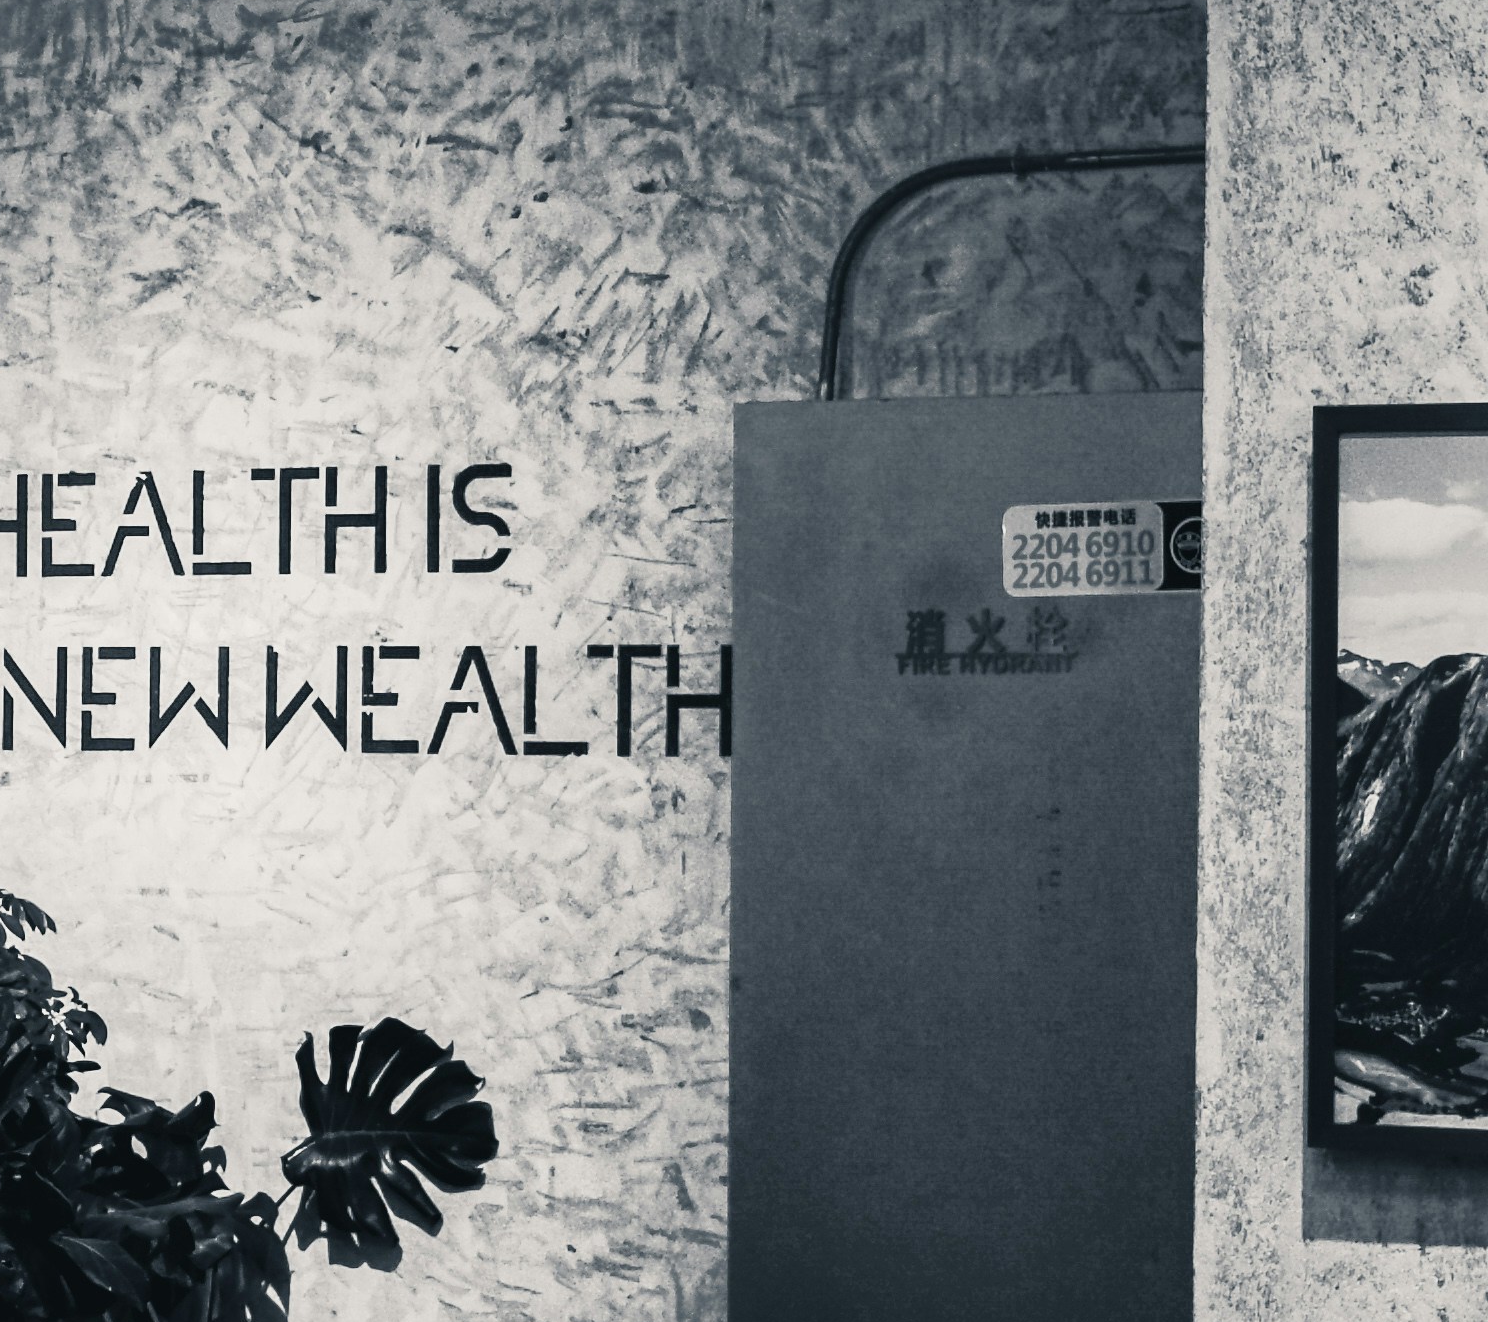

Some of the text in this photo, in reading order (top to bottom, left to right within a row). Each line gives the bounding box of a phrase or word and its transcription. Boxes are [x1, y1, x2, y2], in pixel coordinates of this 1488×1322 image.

[427, 462, 514, 575] IS
[1035, 508, 1136, 529] 快捷报警电话
[1012, 530, 1155, 561] 2204 6910
[1012, 558, 1155, 589] 2204 6911
[896, 652, 1078, 675] FIRE HYDRANT
[1, 645, 230, 752] NEW
[264, 643, 733, 758] WEALTH
